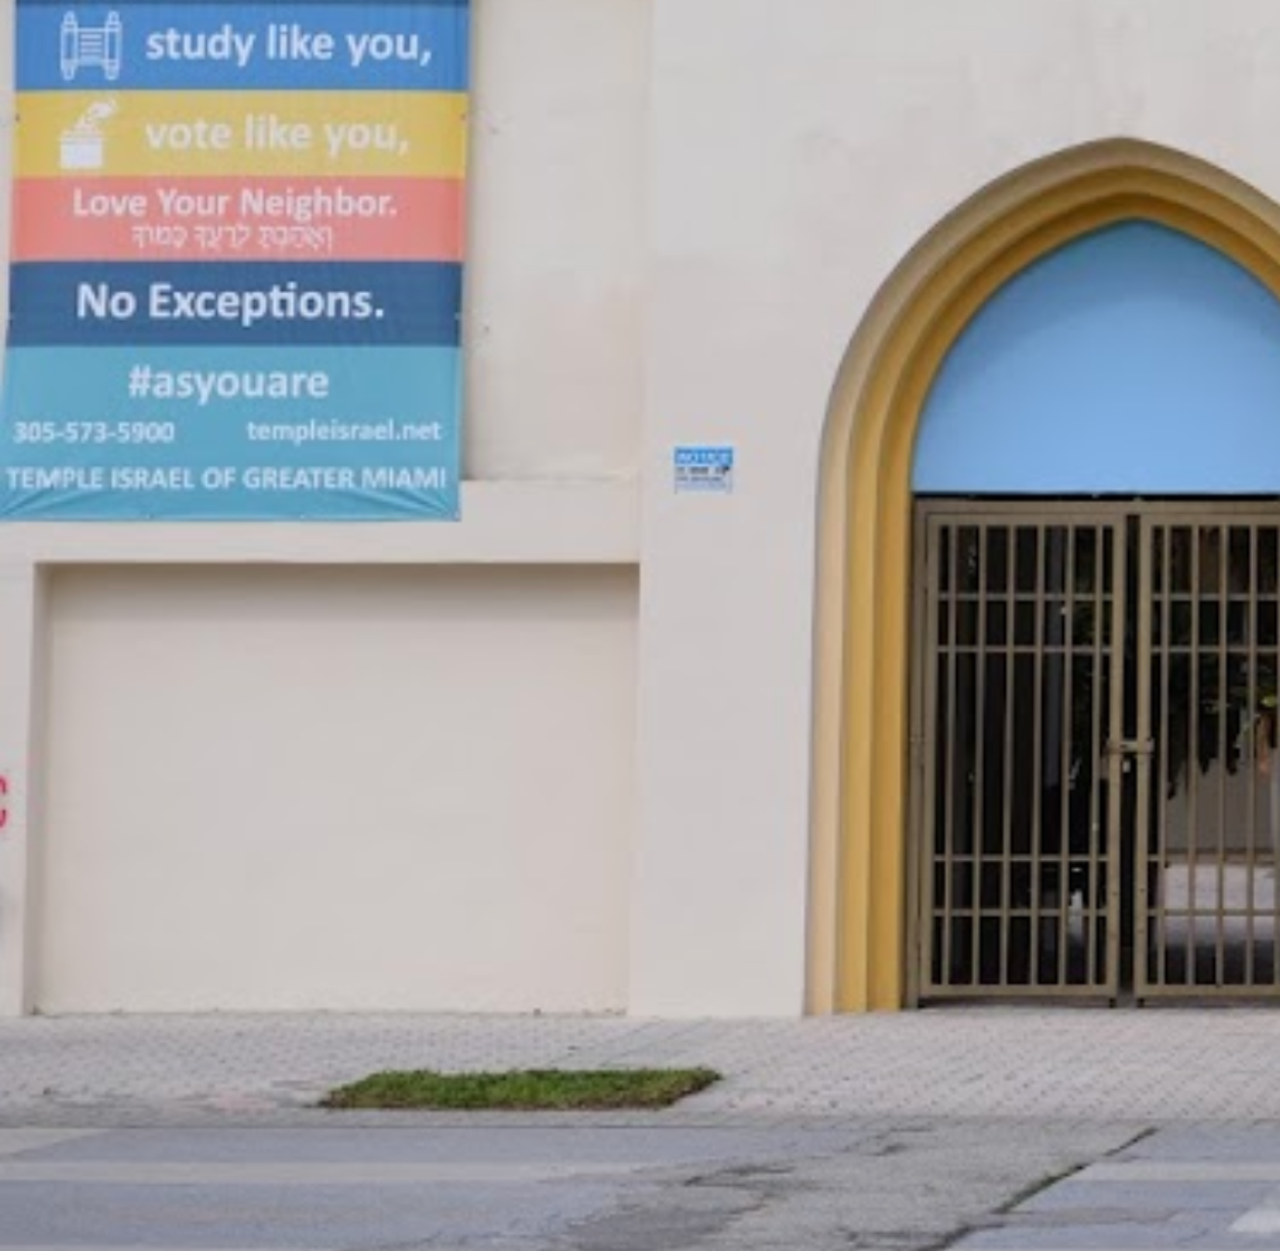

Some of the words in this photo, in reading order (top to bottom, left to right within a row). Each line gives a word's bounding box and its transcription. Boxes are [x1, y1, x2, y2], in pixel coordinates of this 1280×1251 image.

[147, 24, 255, 66] study
[268, 24, 334, 59] like
[346, 34, 431, 66] you,
[146, 120, 232, 150] vote
[246, 115, 311, 150] like
[325, 124, 408, 158] you,
[74, 189, 149, 216] Love
[157, 189, 229, 216] Your
[241, 188, 397, 223] Neighbor.
[78, 284, 135, 318] No
[150, 282, 384, 326] Exceptions.
[129, 366, 329, 405] #asyouare
[14, 421, 175, 443] 305-573-5900
[247, 419, 442, 445] templeisrael.net
[6, 467, 106, 489] TEMPLE
[111, 467, 194, 489] ISRAEL
[203, 467, 235, 489] OF
[242, 467, 354, 489] GREATER
[361, 467, 446, 489] MIAMI
